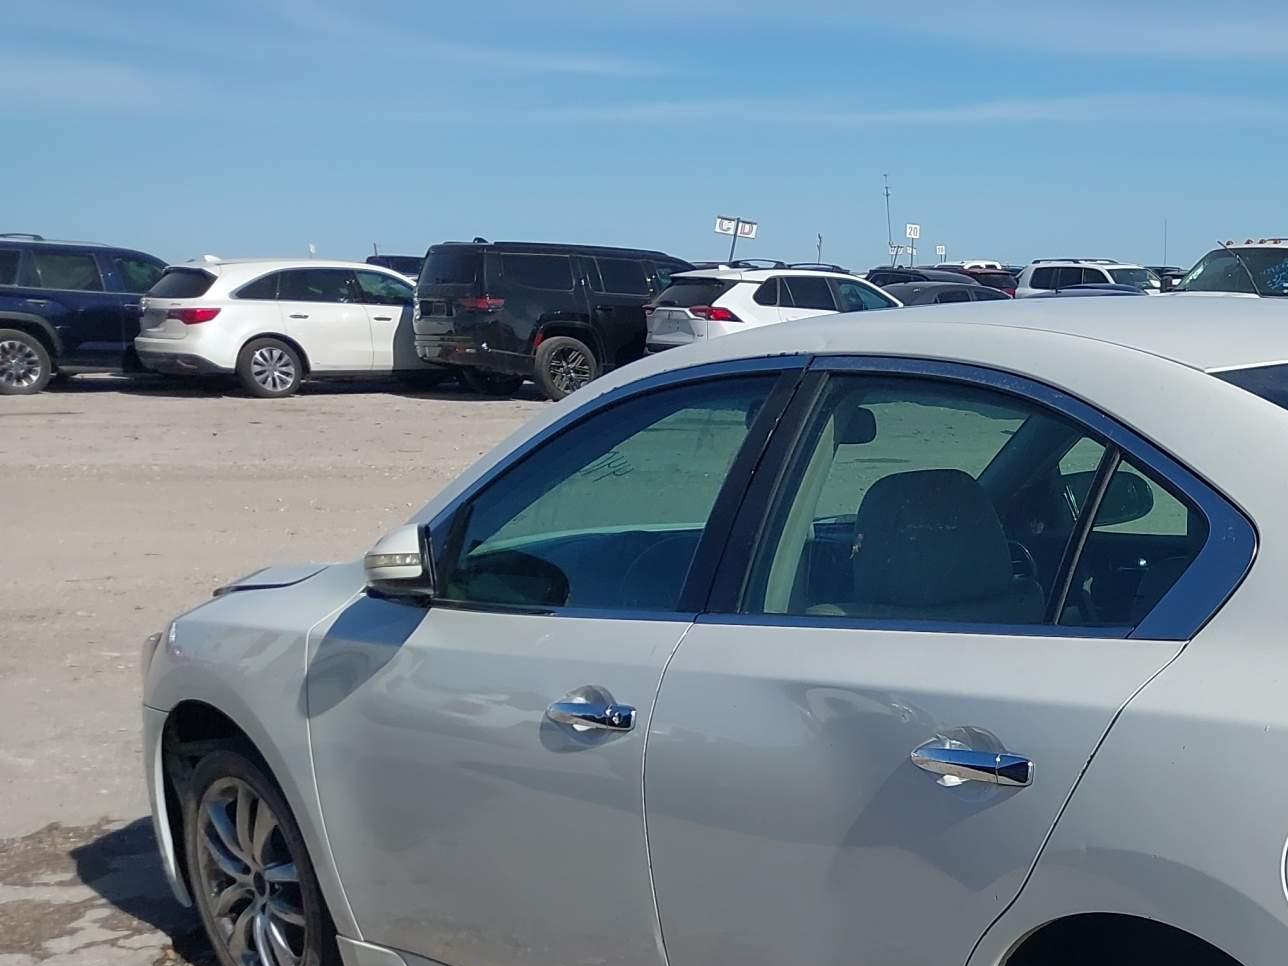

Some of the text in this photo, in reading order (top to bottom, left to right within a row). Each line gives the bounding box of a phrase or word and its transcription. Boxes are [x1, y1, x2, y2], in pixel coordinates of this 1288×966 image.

[718, 219, 754, 236] C D
[908, 226, 918, 237] 20
